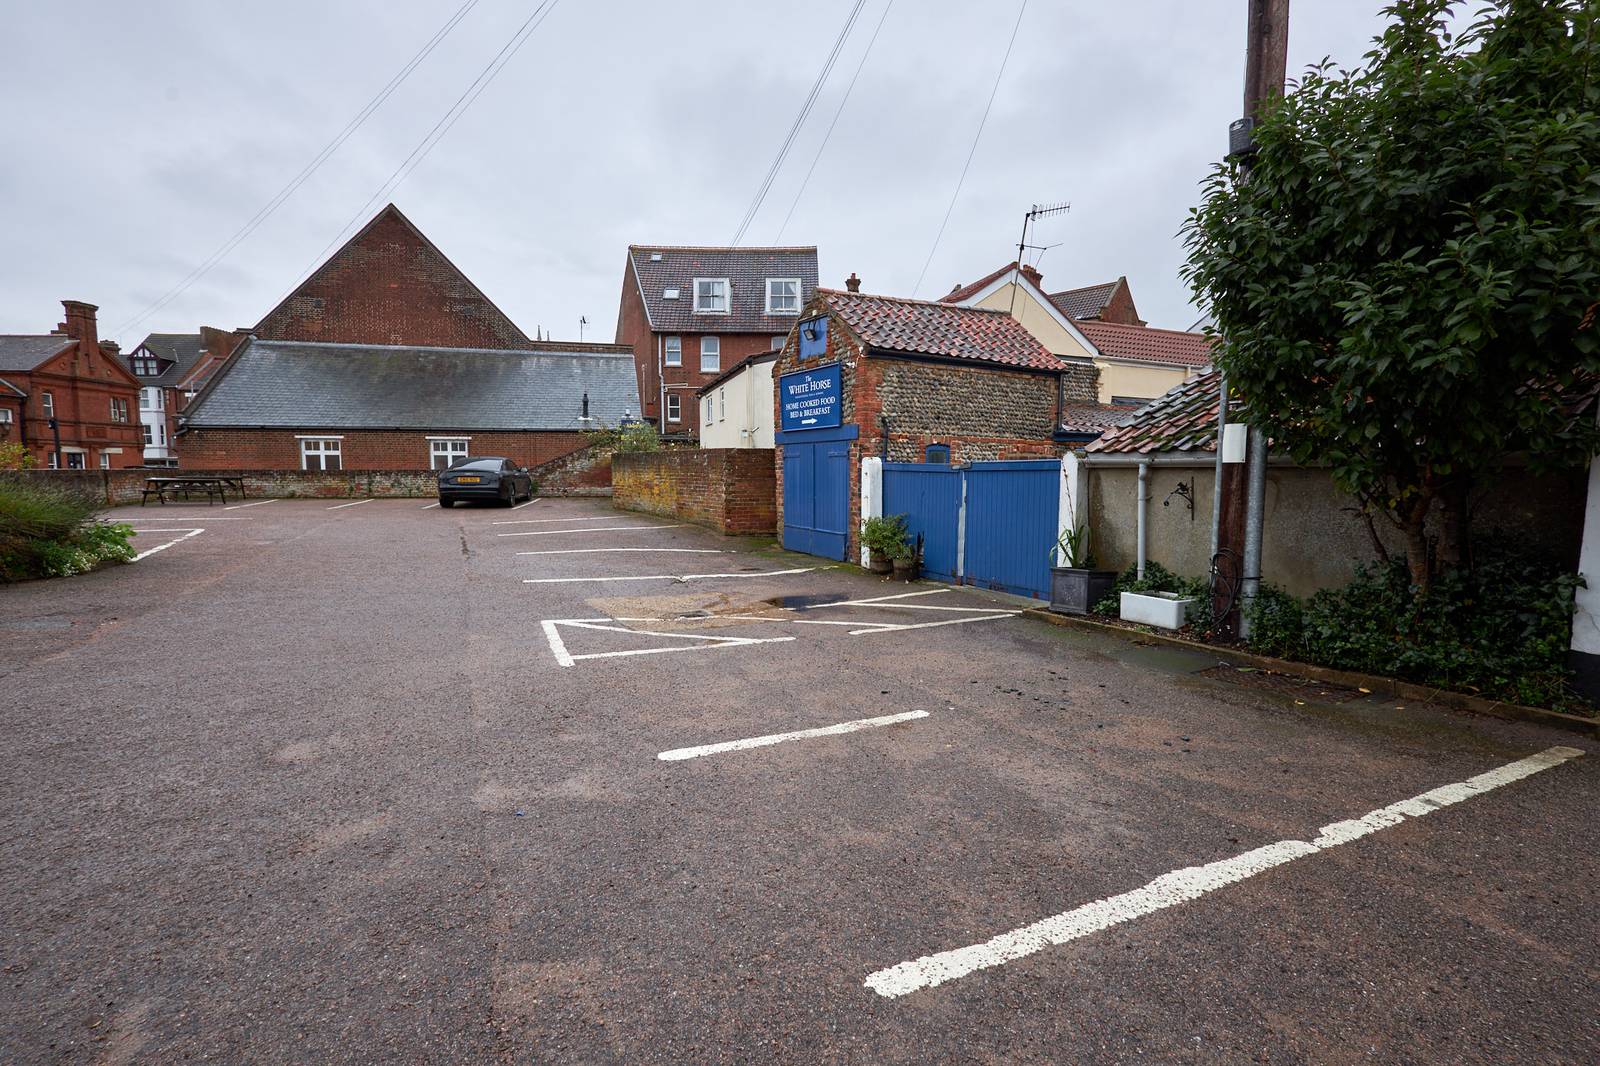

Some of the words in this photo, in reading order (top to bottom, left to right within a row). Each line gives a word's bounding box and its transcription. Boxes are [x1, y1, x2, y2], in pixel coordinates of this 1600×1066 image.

[789, 384, 809, 394] WHITE
[810, 379, 831, 391] HORSE
[786, 402, 799, 410] HOME
[800, 399, 819, 408] COOKED
[821, 396, 835, 405] FOOD
[804, 407, 830, 416] BREAKFAST
